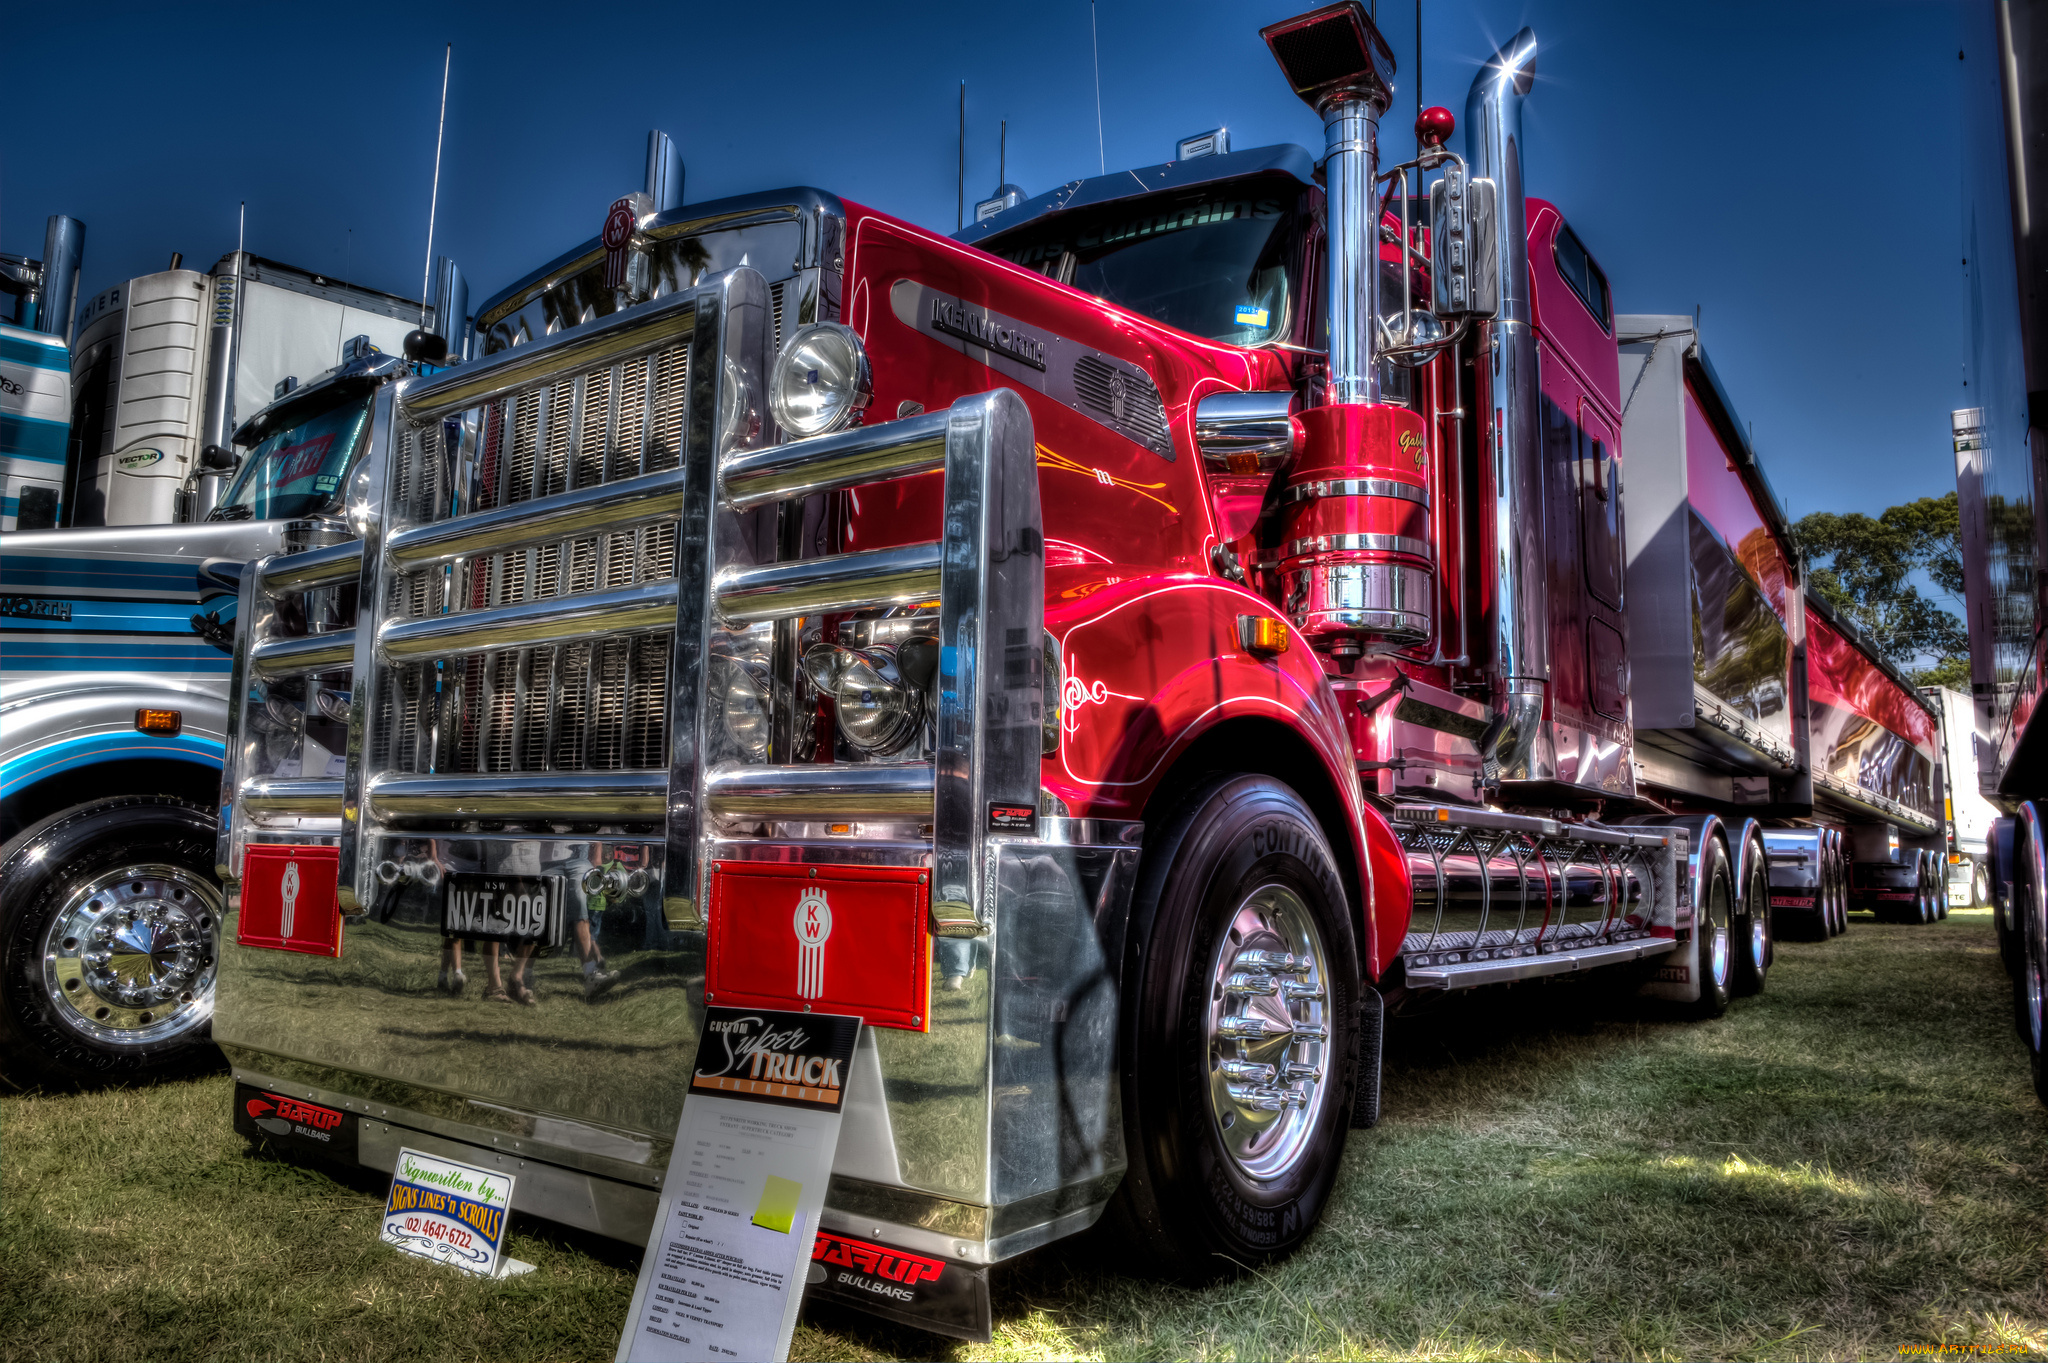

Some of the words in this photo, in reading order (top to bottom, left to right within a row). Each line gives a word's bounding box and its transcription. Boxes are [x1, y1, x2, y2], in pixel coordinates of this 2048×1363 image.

[932, 296, 1047, 365] KENWORTH
[119, 453, 158, 465] VECTOR
[484, 881, 506, 890] NSW
[807, 905, 818, 922] K
[805, 921, 821, 938] W
[709, 1020, 749, 1035] CUSTOM
[749, 1048, 843, 1090] TRUCK
[718, 1078, 825, 1101] ENTRANT
[294, 1125, 331, 1142] BULLBARS
[769, 1130, 794, 1138] CATEGORY
[400, 1156, 473, 1192] Signwritten
[389, 1184, 420, 1213] SIGNS
[418, 1190, 446, 1212] LINES
[458, 1201, 502, 1242] SCROLLS
[404, 1216, 422, 1234] (02)
[837, 1272, 915, 1303] BULLBARS
[703, 1318, 724, 1329] TRANSPORT
